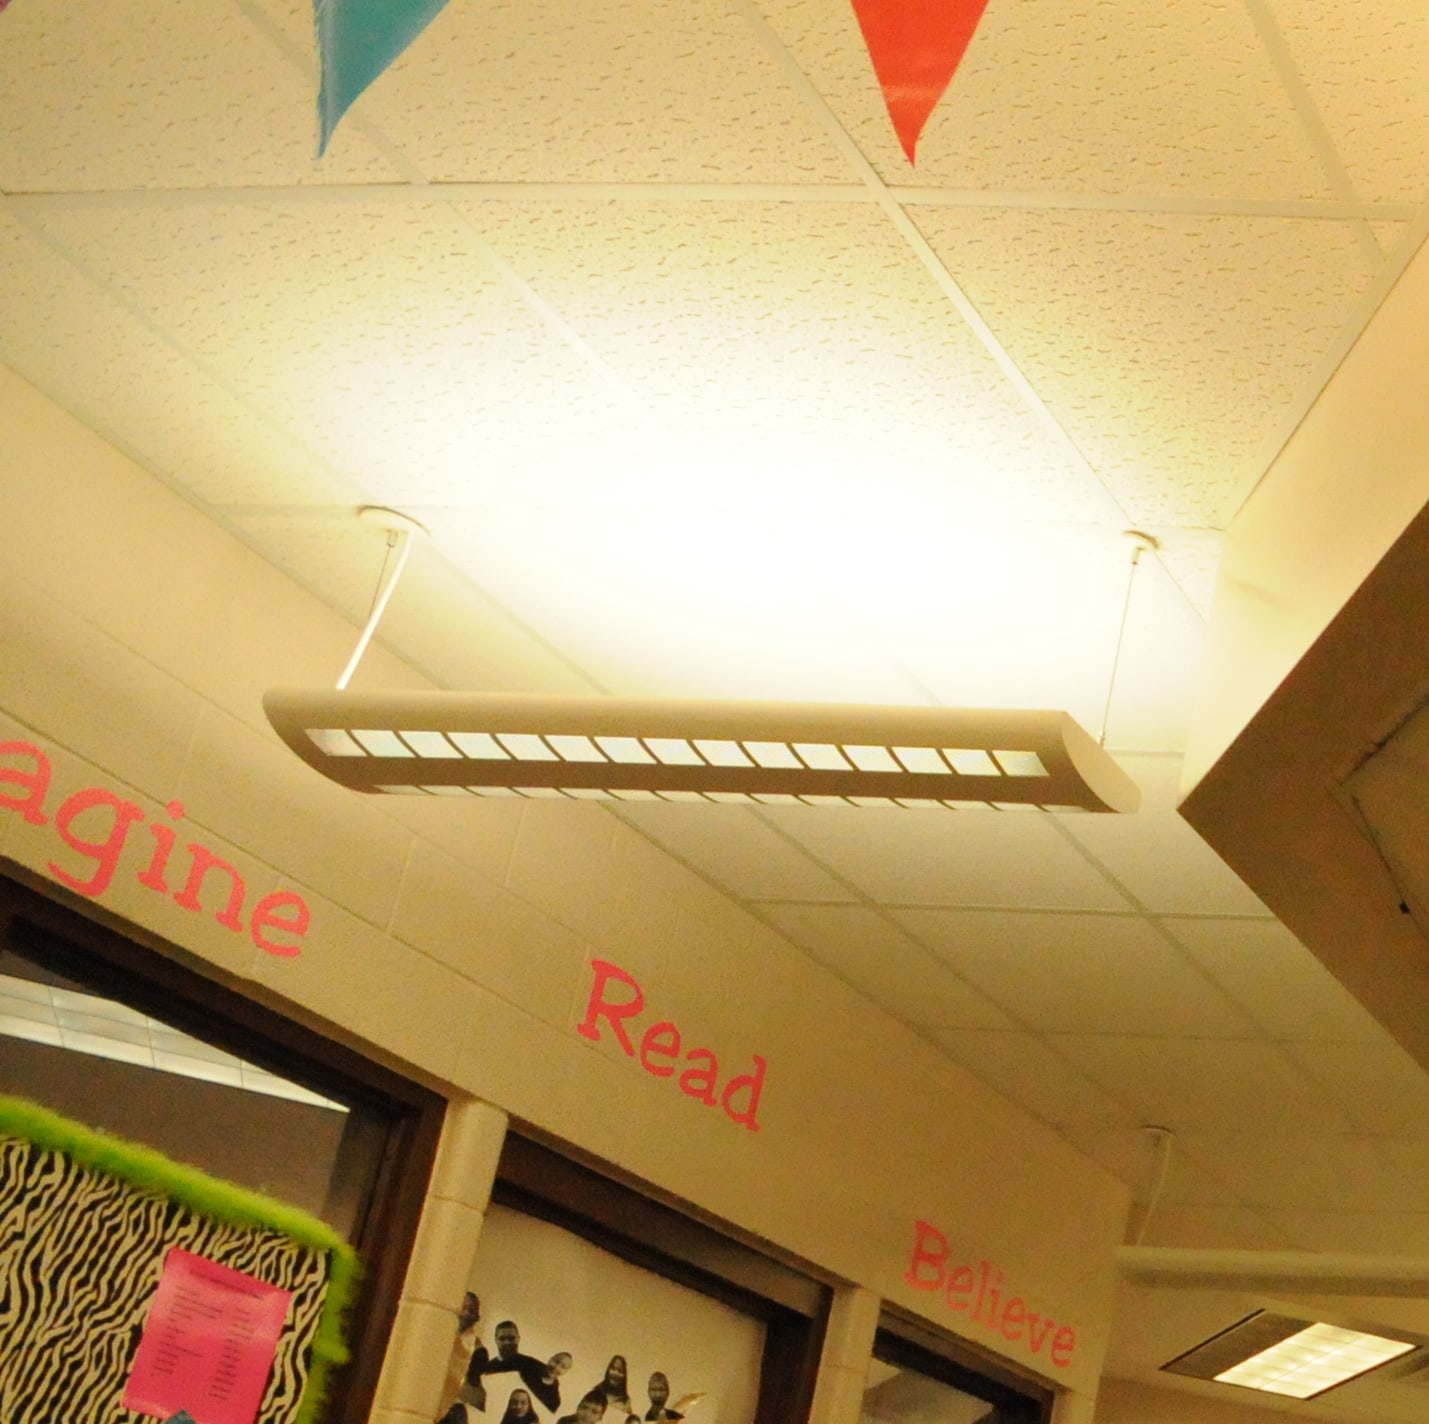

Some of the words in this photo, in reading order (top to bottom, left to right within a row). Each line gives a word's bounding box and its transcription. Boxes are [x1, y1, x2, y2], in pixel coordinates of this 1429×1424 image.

[0, 739, 312, 959] agine
[576, 959, 768, 1132] Read
[905, 1220, 1074, 1367] Believe
